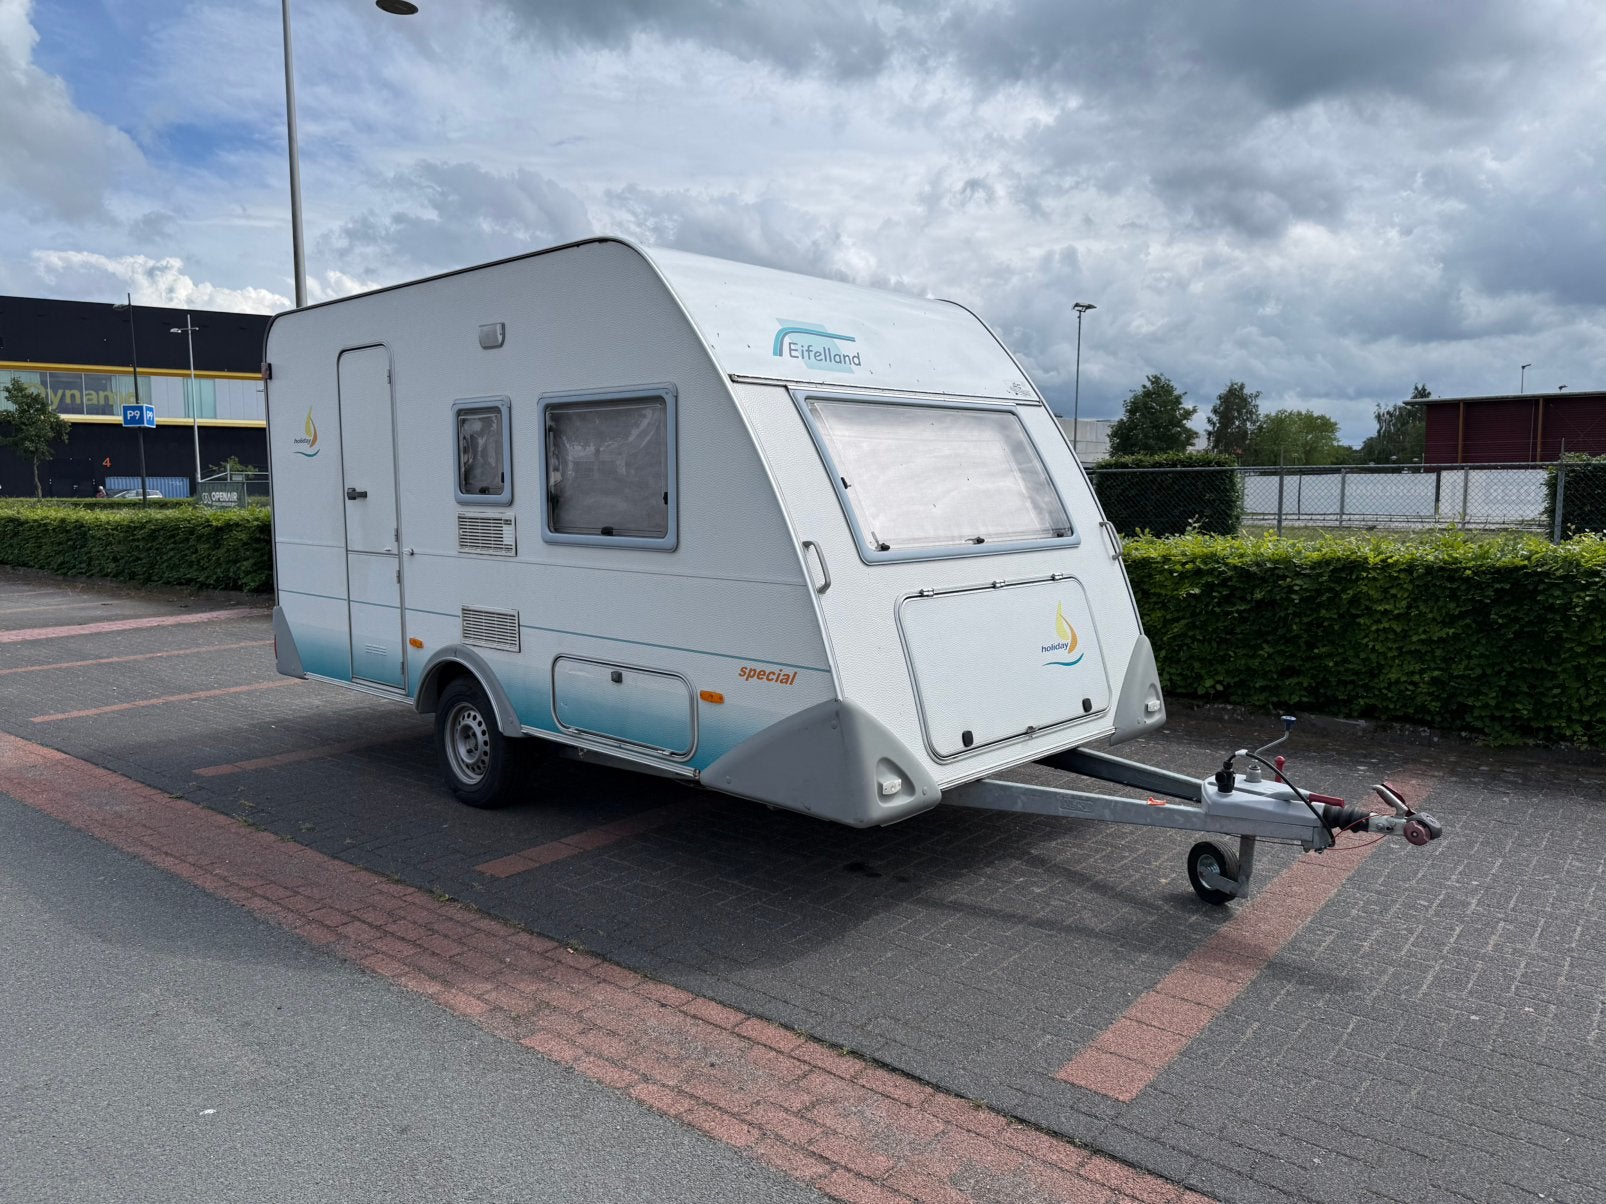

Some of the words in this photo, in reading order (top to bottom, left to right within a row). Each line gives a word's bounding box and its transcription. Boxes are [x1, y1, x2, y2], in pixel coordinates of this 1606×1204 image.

[788, 341, 862, 367] Eifelland
[127, 410, 141, 420] P9
[146, 410, 154, 421] P9
[102, 457, 112, 468] 4
[1041, 642, 1069, 653] holiday
[738, 666, 798, 686] special
